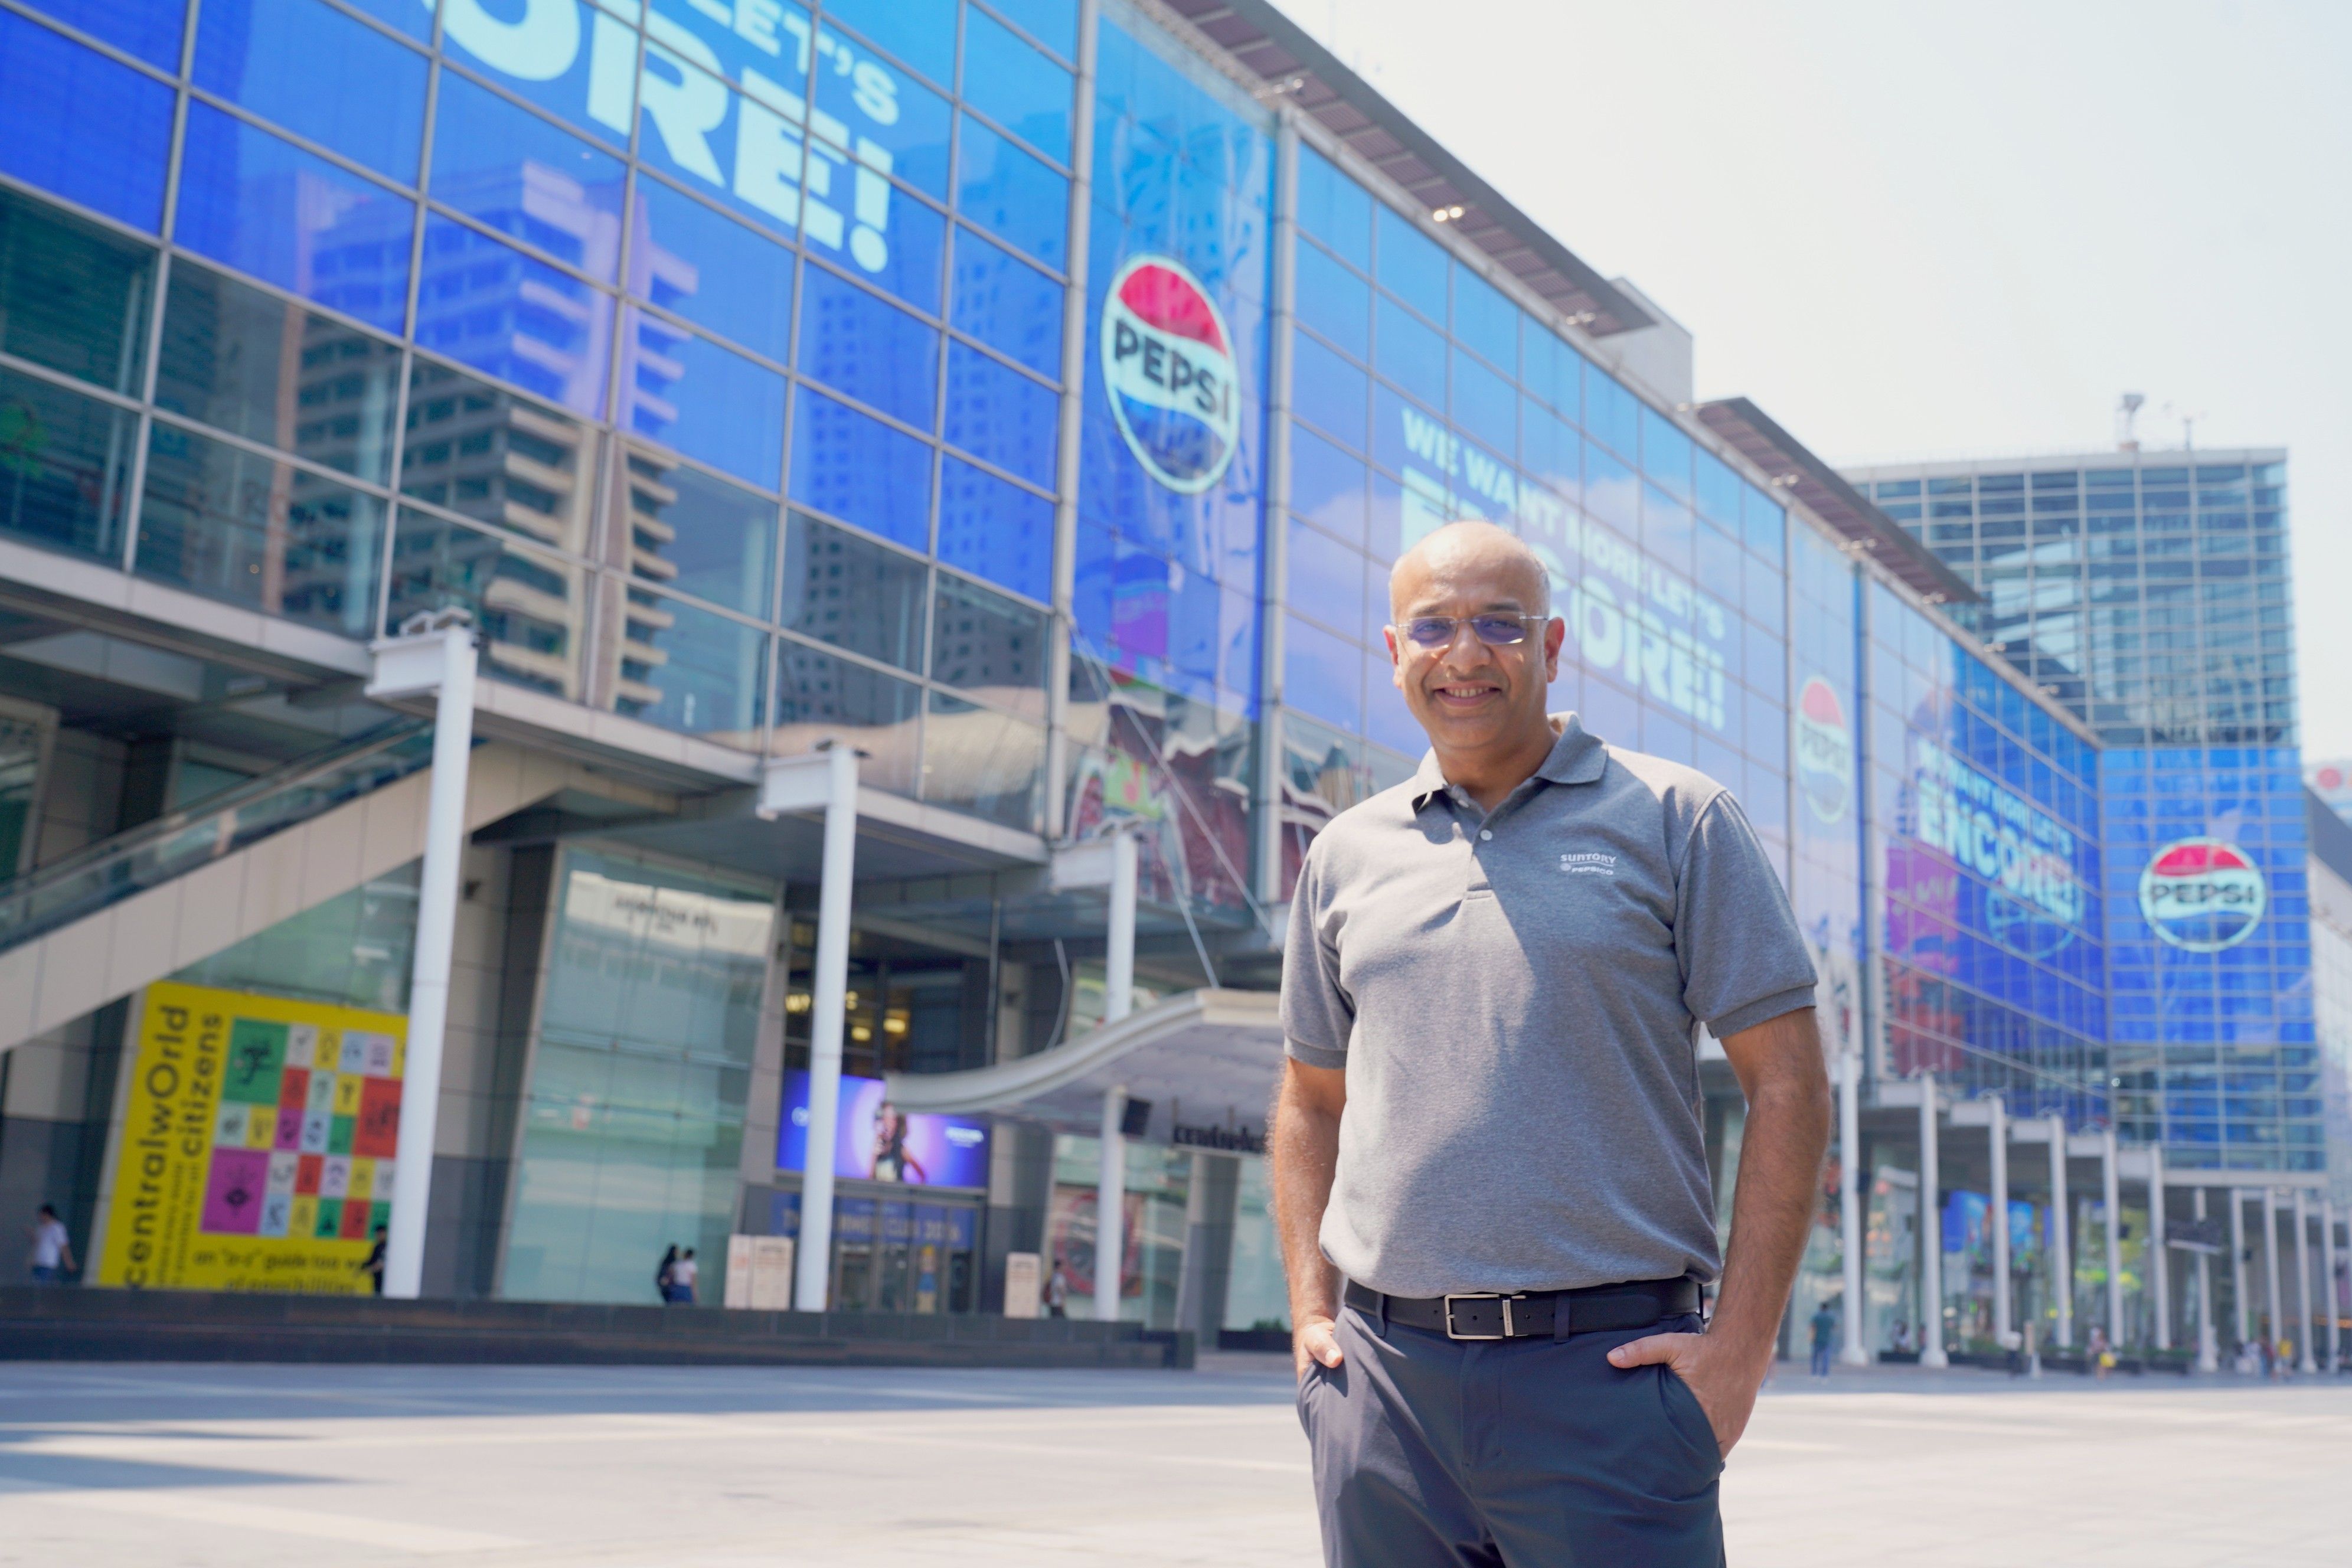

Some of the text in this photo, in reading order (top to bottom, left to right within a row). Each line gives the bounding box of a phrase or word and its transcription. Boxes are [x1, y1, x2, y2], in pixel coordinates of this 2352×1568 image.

[1115, 318, 1229, 424] PEPSI
[1402, 409, 1460, 476] WE
[1464, 447, 1562, 536] WANT
[1651, 568, 1726, 641] LET'S
[2151, 884, 2253, 904] PEPSI
[177, 1014, 222, 1157] citizens
